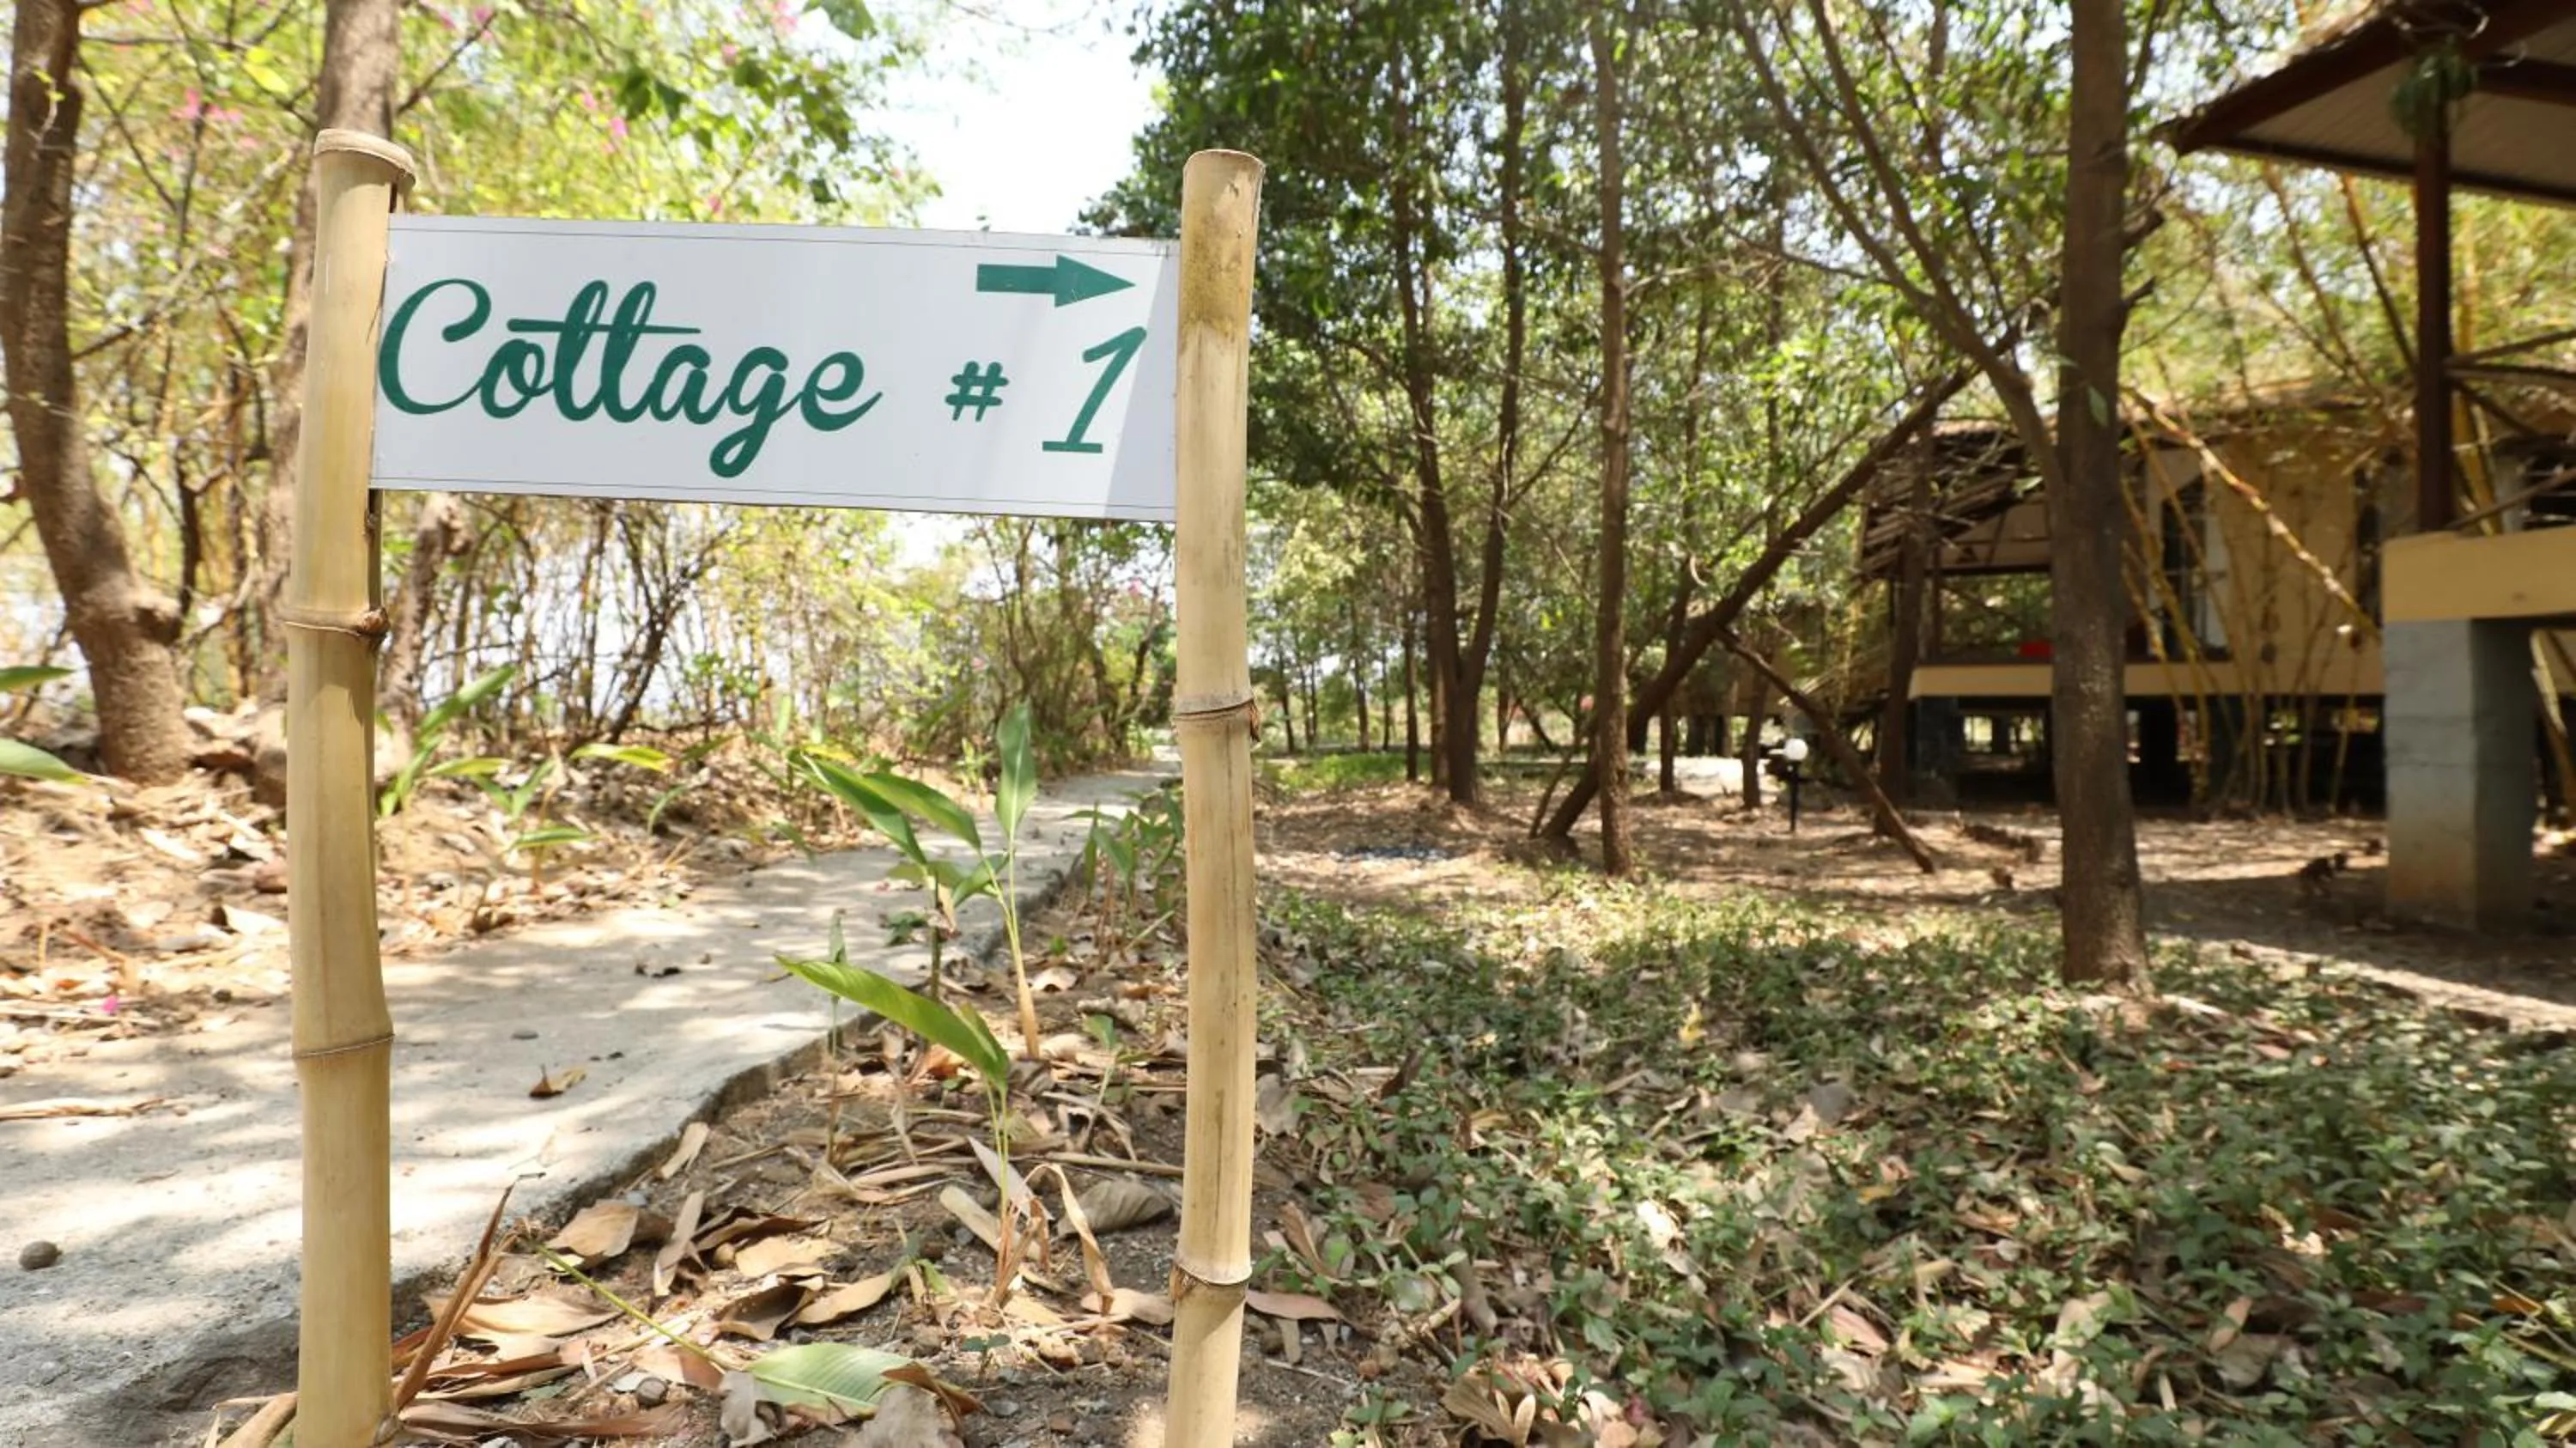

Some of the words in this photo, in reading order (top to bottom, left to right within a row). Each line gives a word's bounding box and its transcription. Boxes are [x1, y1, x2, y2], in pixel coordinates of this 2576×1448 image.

[379, 279, 882, 478] Cottage
[945, 361, 1009, 423] #
[1042, 325, 1147, 453] 1
